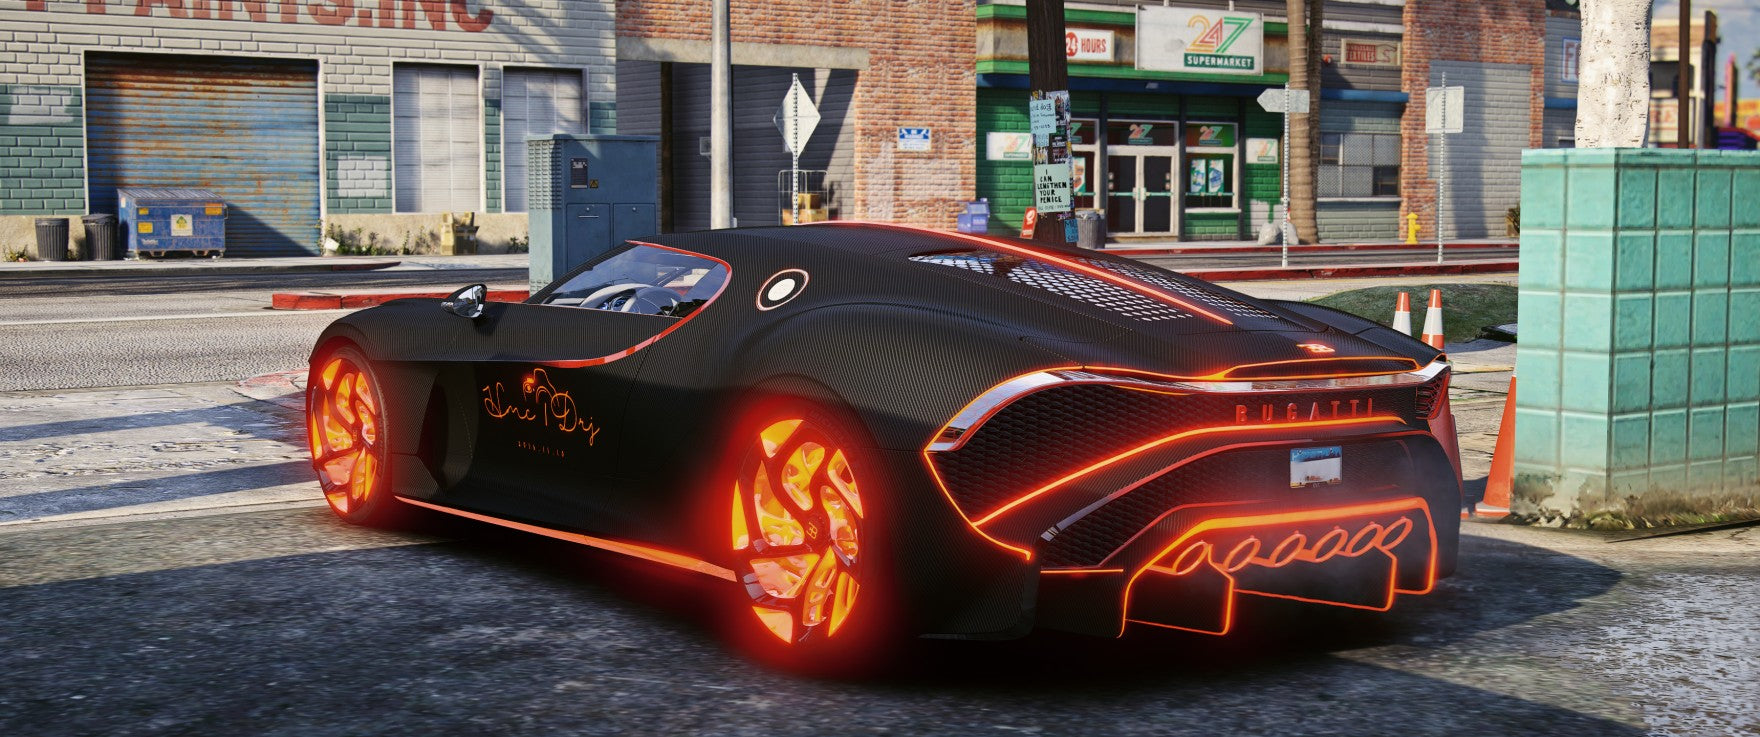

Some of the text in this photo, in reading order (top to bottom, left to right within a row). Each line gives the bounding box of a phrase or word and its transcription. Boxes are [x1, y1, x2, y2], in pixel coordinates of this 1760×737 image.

[1081, 38, 1107, 53] HOURS
[1187, 56, 1252, 67] SUPERMARKET
[1037, 181, 1067, 189] LENGTHEN
[1235, 398, 1373, 424] BUGATTI
